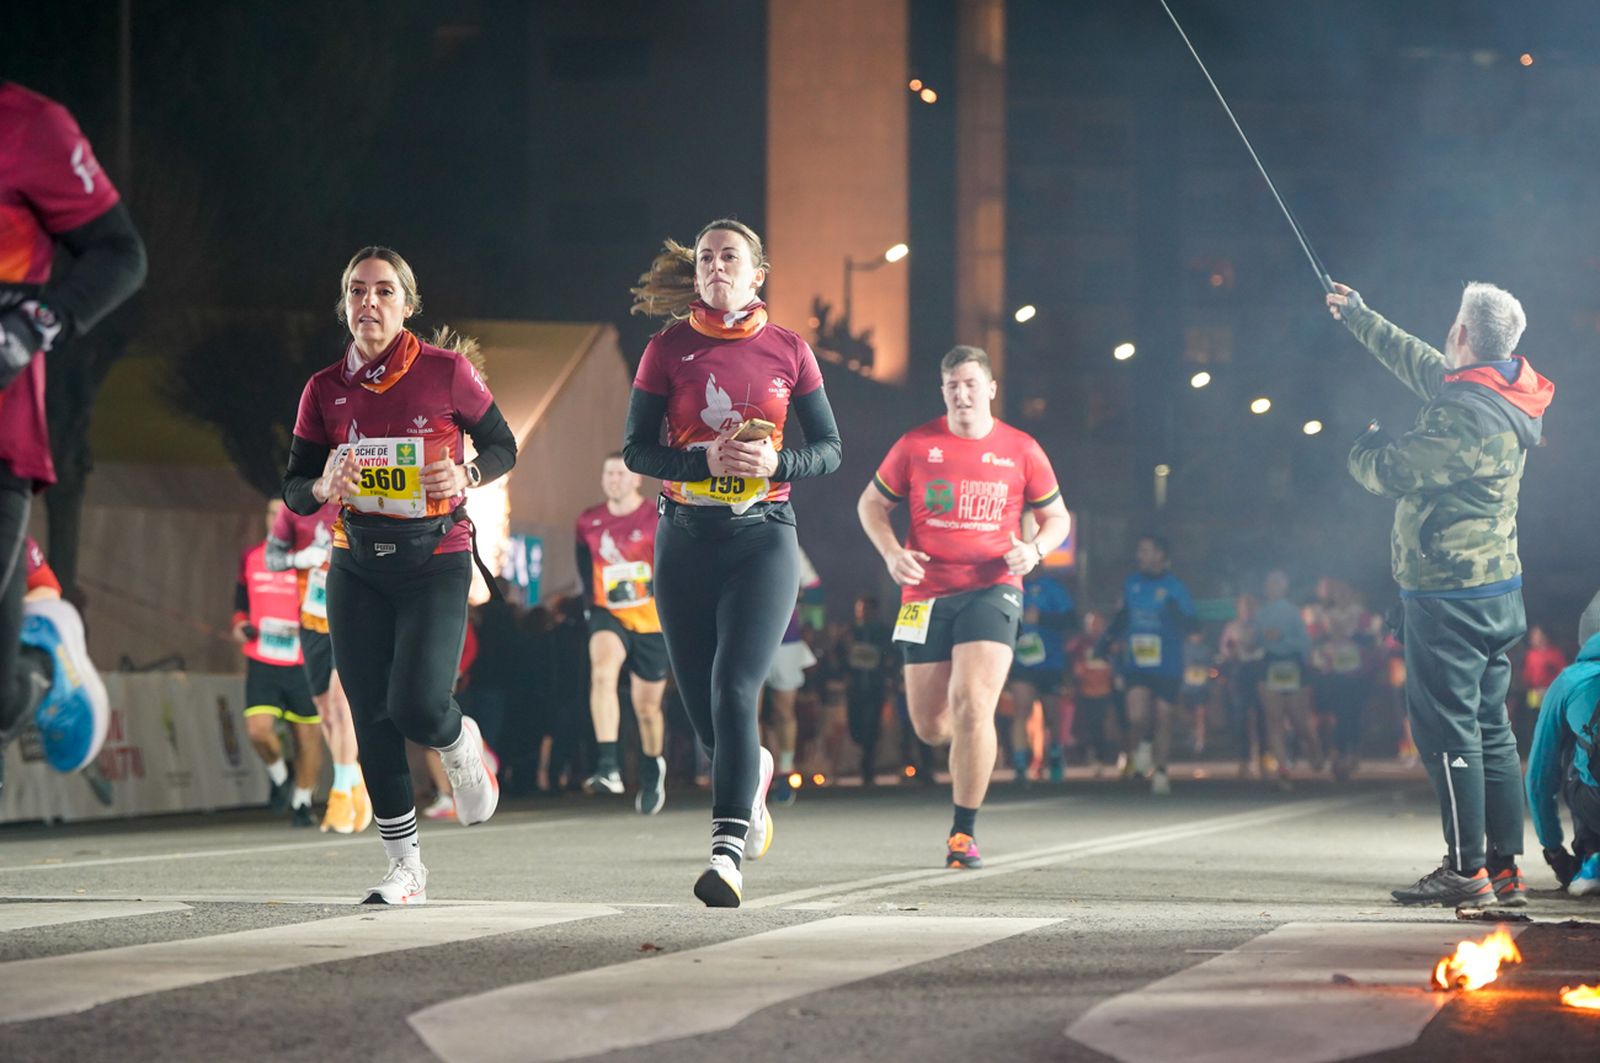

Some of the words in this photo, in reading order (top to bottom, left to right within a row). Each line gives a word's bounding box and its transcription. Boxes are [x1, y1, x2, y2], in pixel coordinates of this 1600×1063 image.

[354, 447, 376, 456] OCHE
[377, 447, 389, 456] DE
[360, 467, 406, 492] 560
[709, 475, 746, 494] 195
[958, 494, 1007, 521] ALBOR
